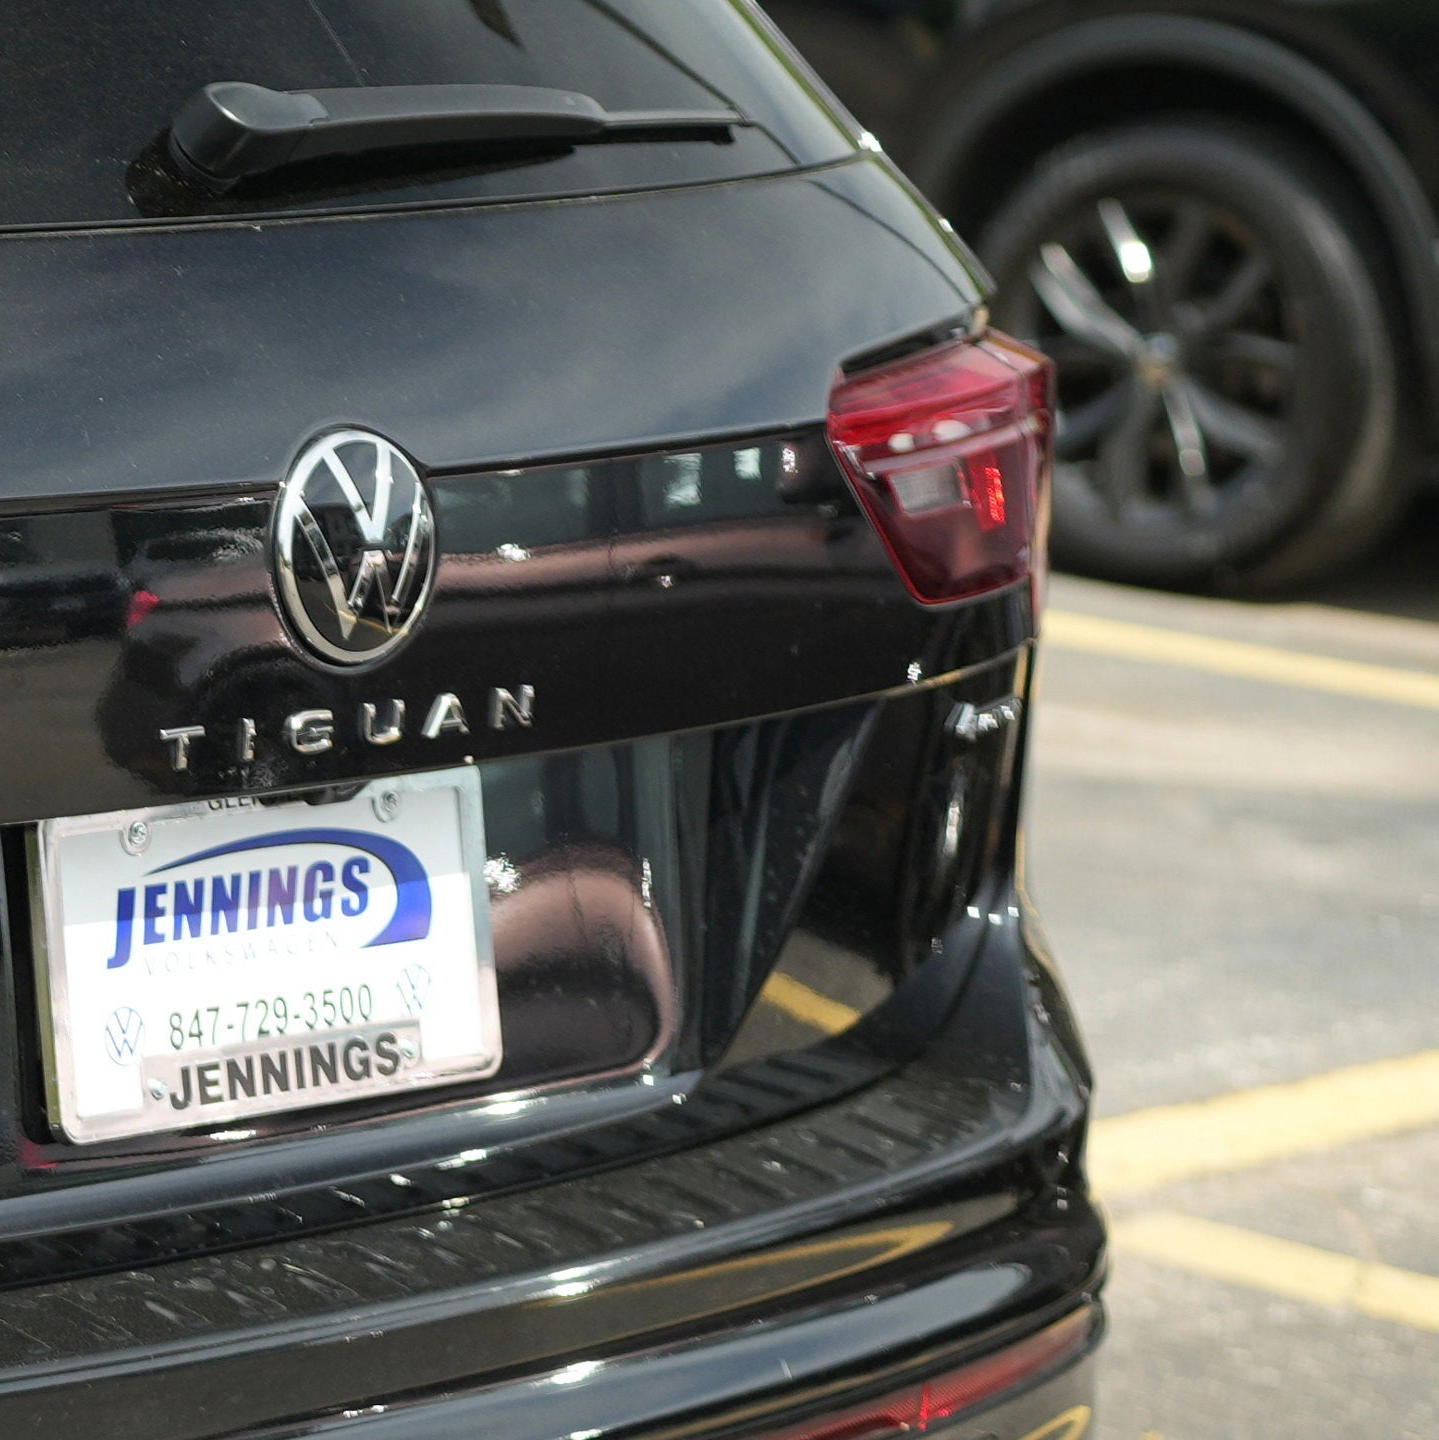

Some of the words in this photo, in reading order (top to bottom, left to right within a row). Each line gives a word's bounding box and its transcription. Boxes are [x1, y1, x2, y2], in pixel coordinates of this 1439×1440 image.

[159, 683, 536, 772] TIGUAN
[107, 854, 371, 970] JENNINGS
[168, 983, 374, 1050] 847-729-3500
[168, 1031, 401, 1111] JENNINGS
